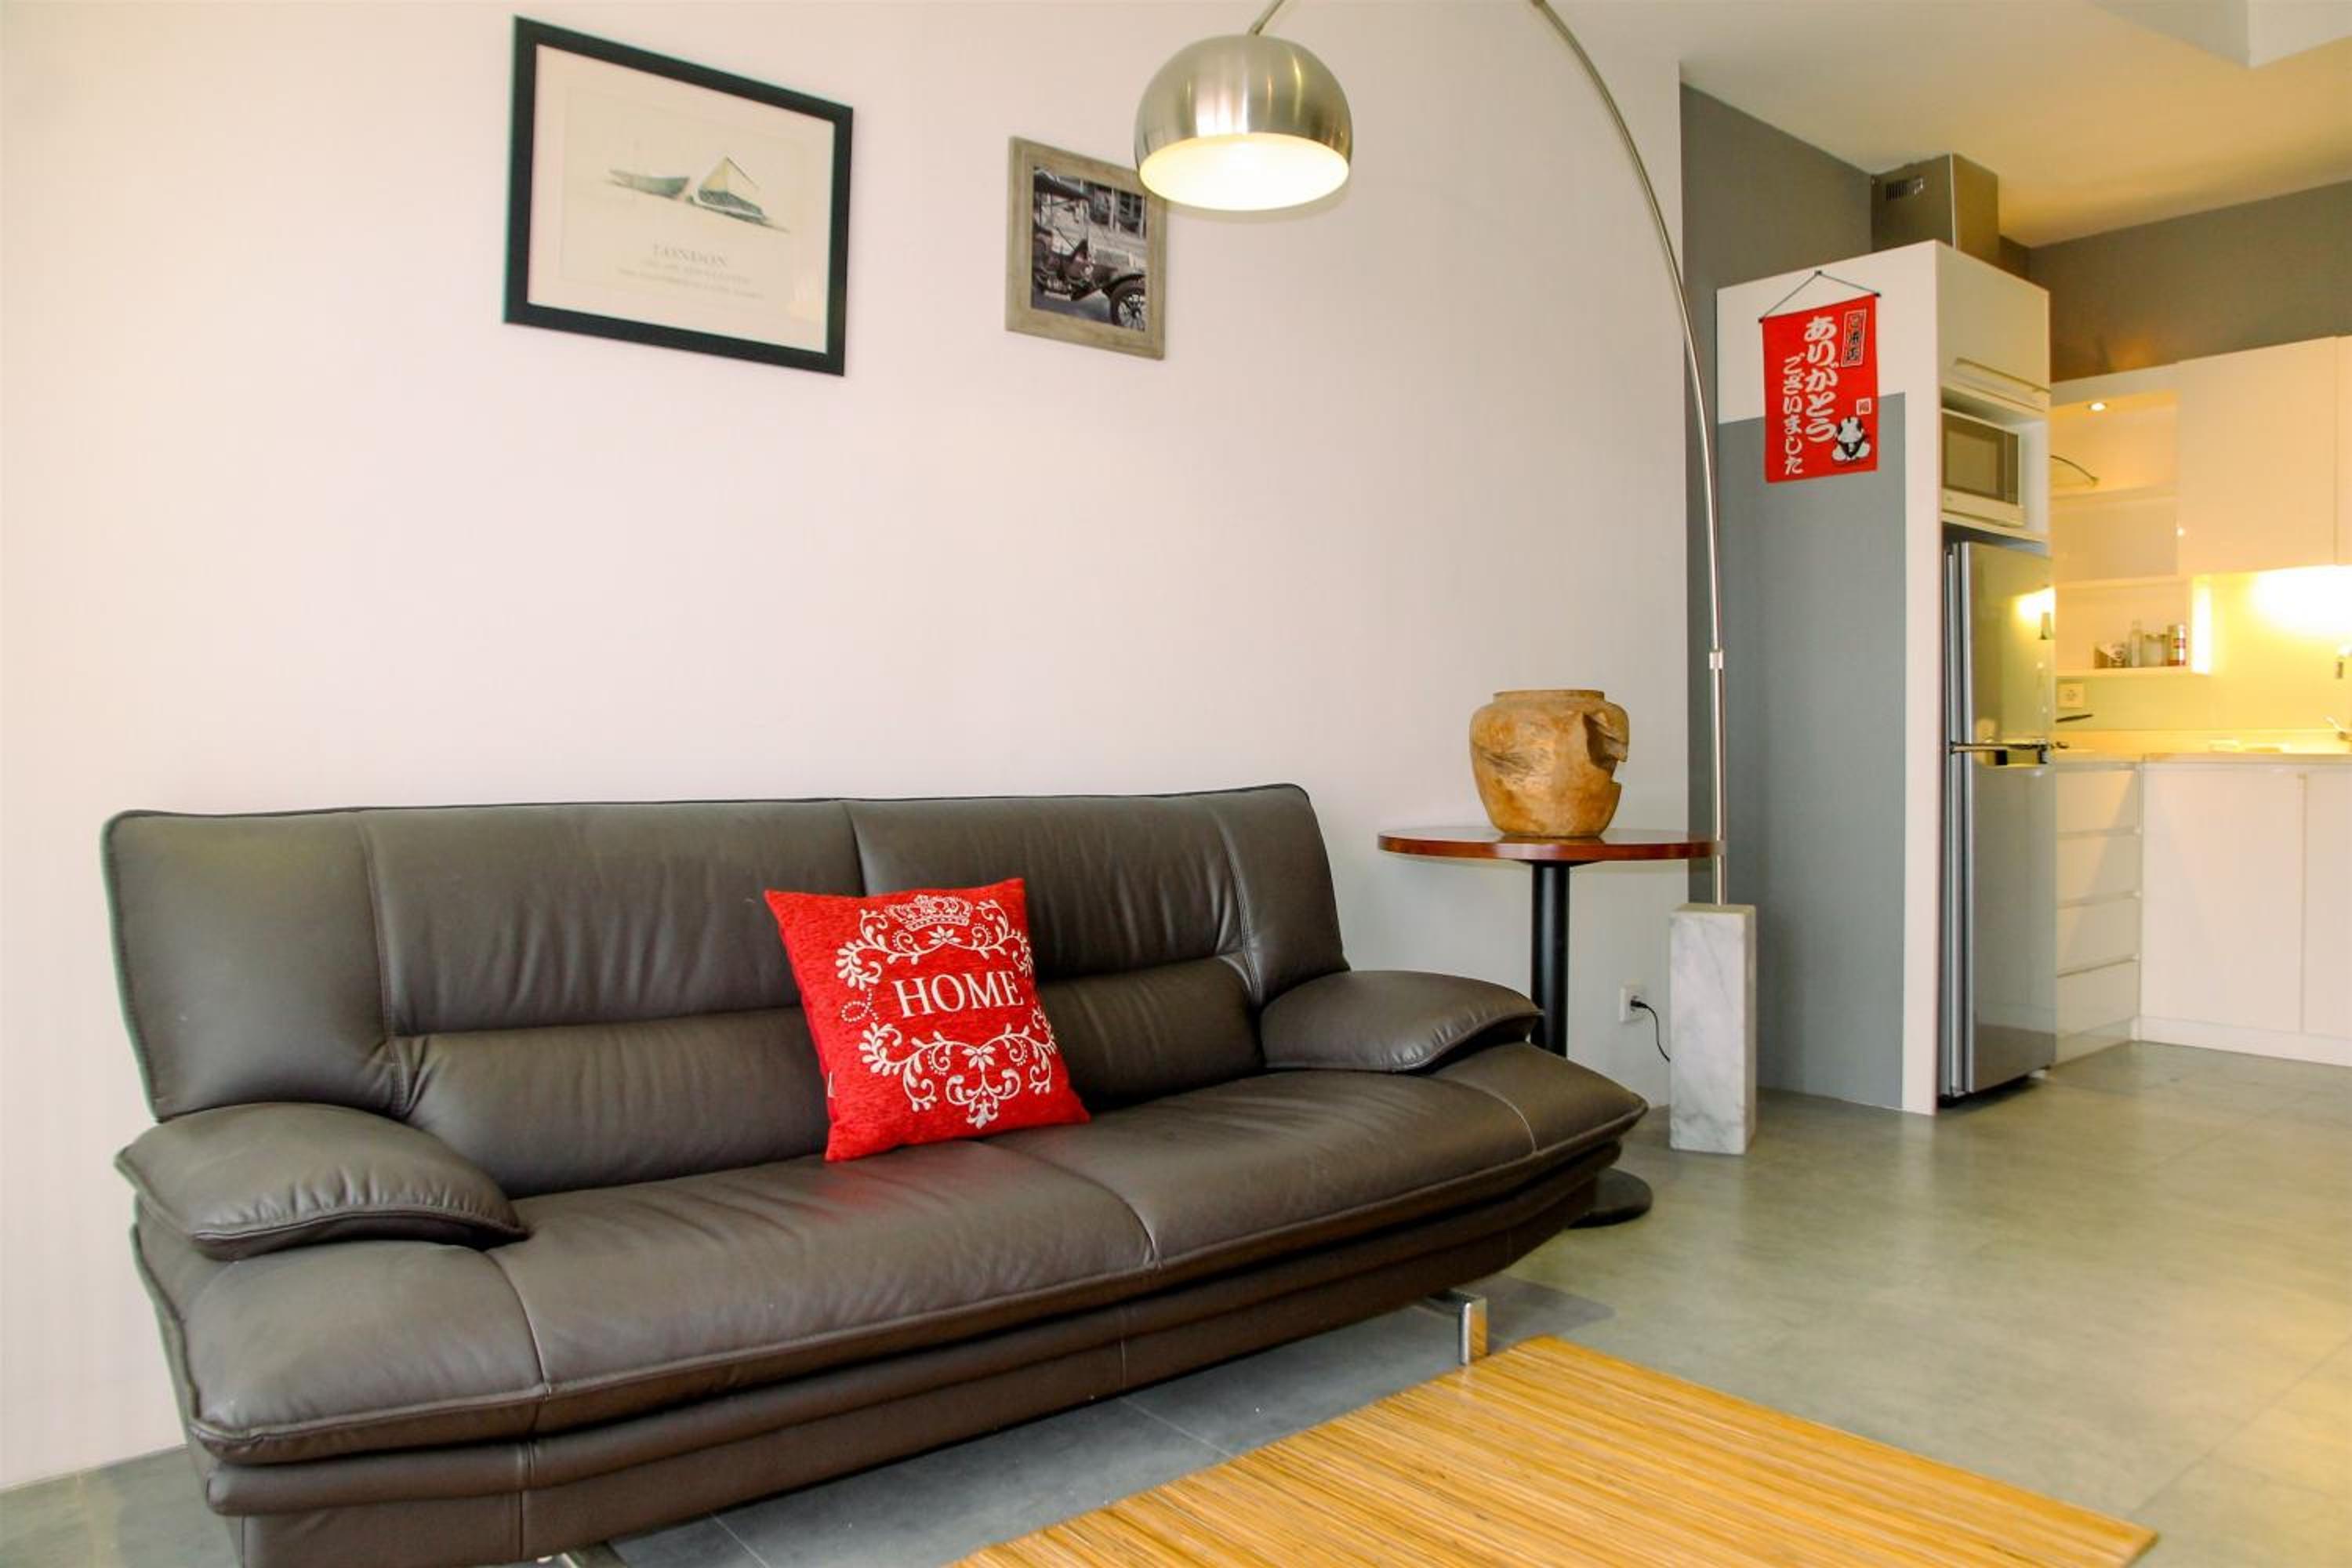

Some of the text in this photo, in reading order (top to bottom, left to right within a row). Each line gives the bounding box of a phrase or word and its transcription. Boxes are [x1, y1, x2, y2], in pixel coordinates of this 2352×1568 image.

[652, 243, 728, 267] LONDON
[1782, 353, 1805, 475] ございました
[1804, 315, 1838, 443] ありがとう
[891, 971, 1024, 1018] HOME
